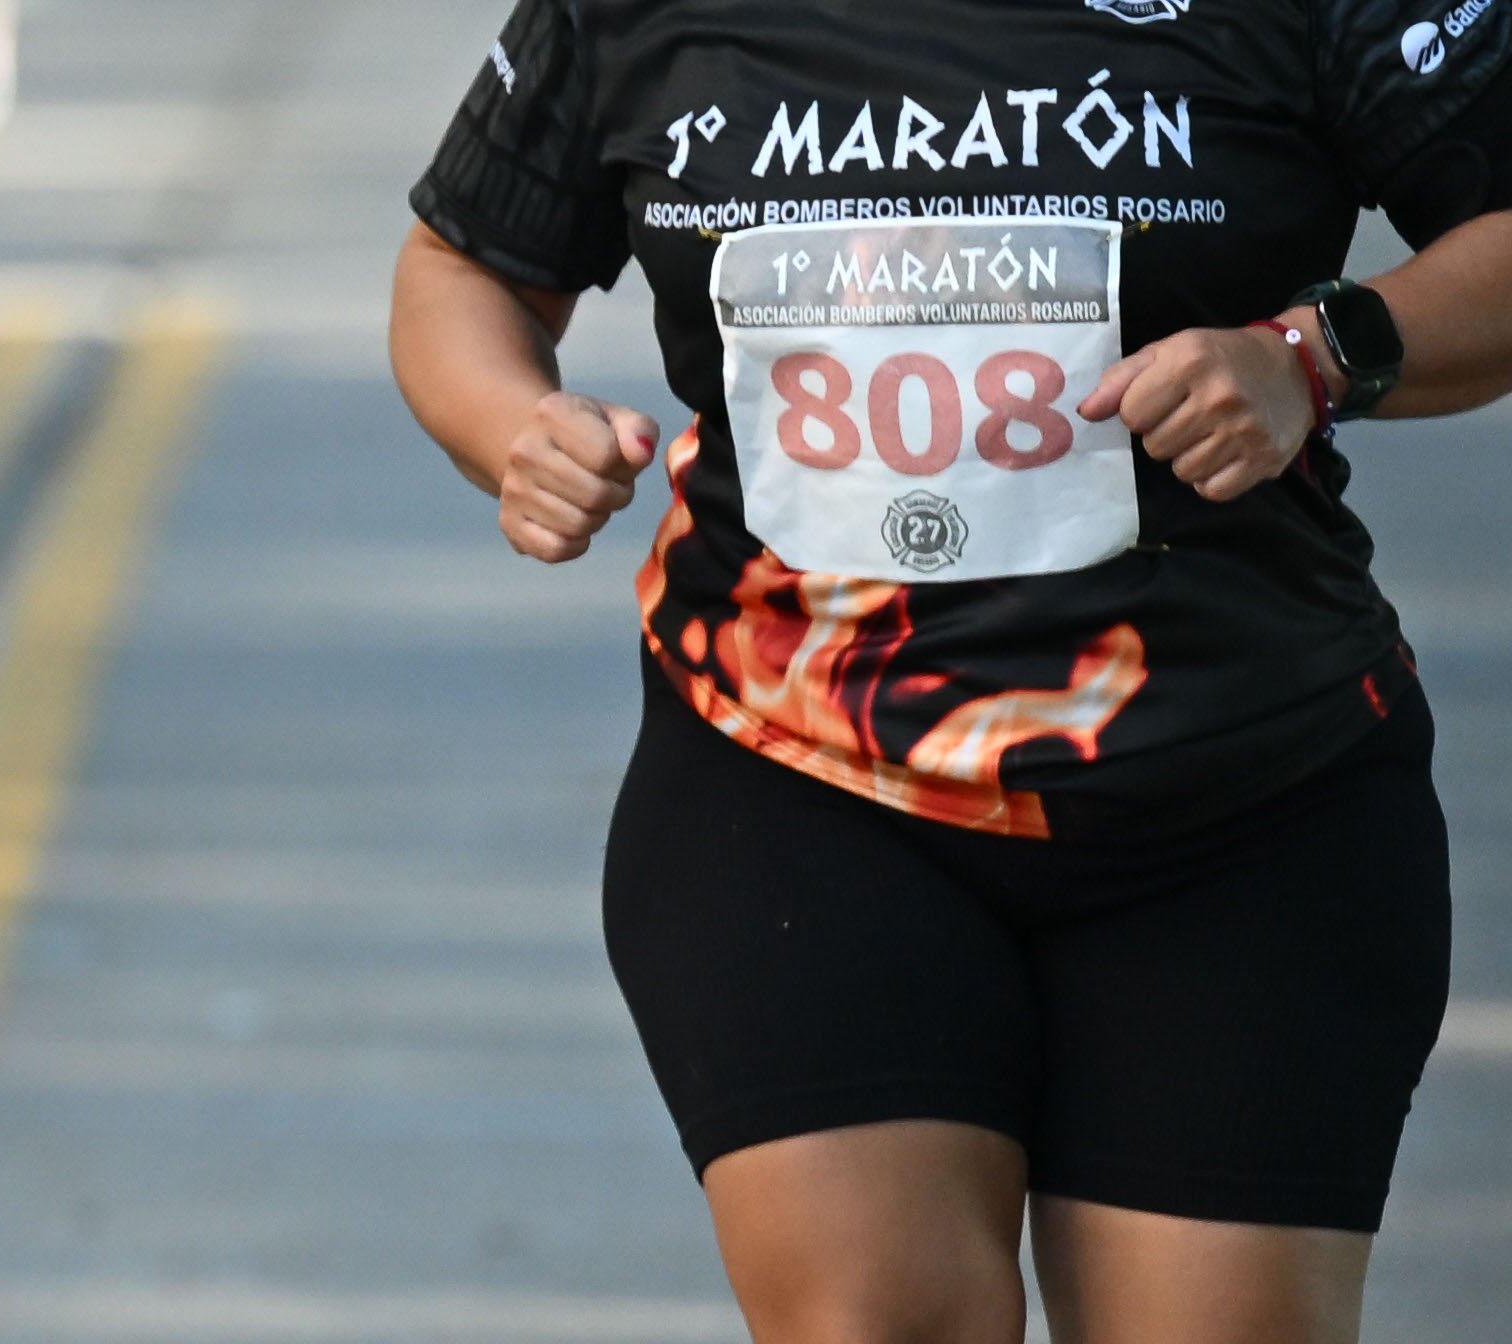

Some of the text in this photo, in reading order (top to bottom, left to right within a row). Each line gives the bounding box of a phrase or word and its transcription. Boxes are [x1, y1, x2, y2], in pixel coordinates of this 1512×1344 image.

[750, 67, 1194, 177] MARATÓN
[644, 194, 1226, 230] ASOCIACIÓN BOMBEROS VOLUNTARIOS ROSARIO
[826, 232, 1057, 294] MARATÓN
[733, 301, 1101, 326] ASOCIACIÓN BOMBEROS VOLUNTARIOS ROSARIO
[770, 348, 1075, 476] 808
[907, 515, 941, 545] 27
